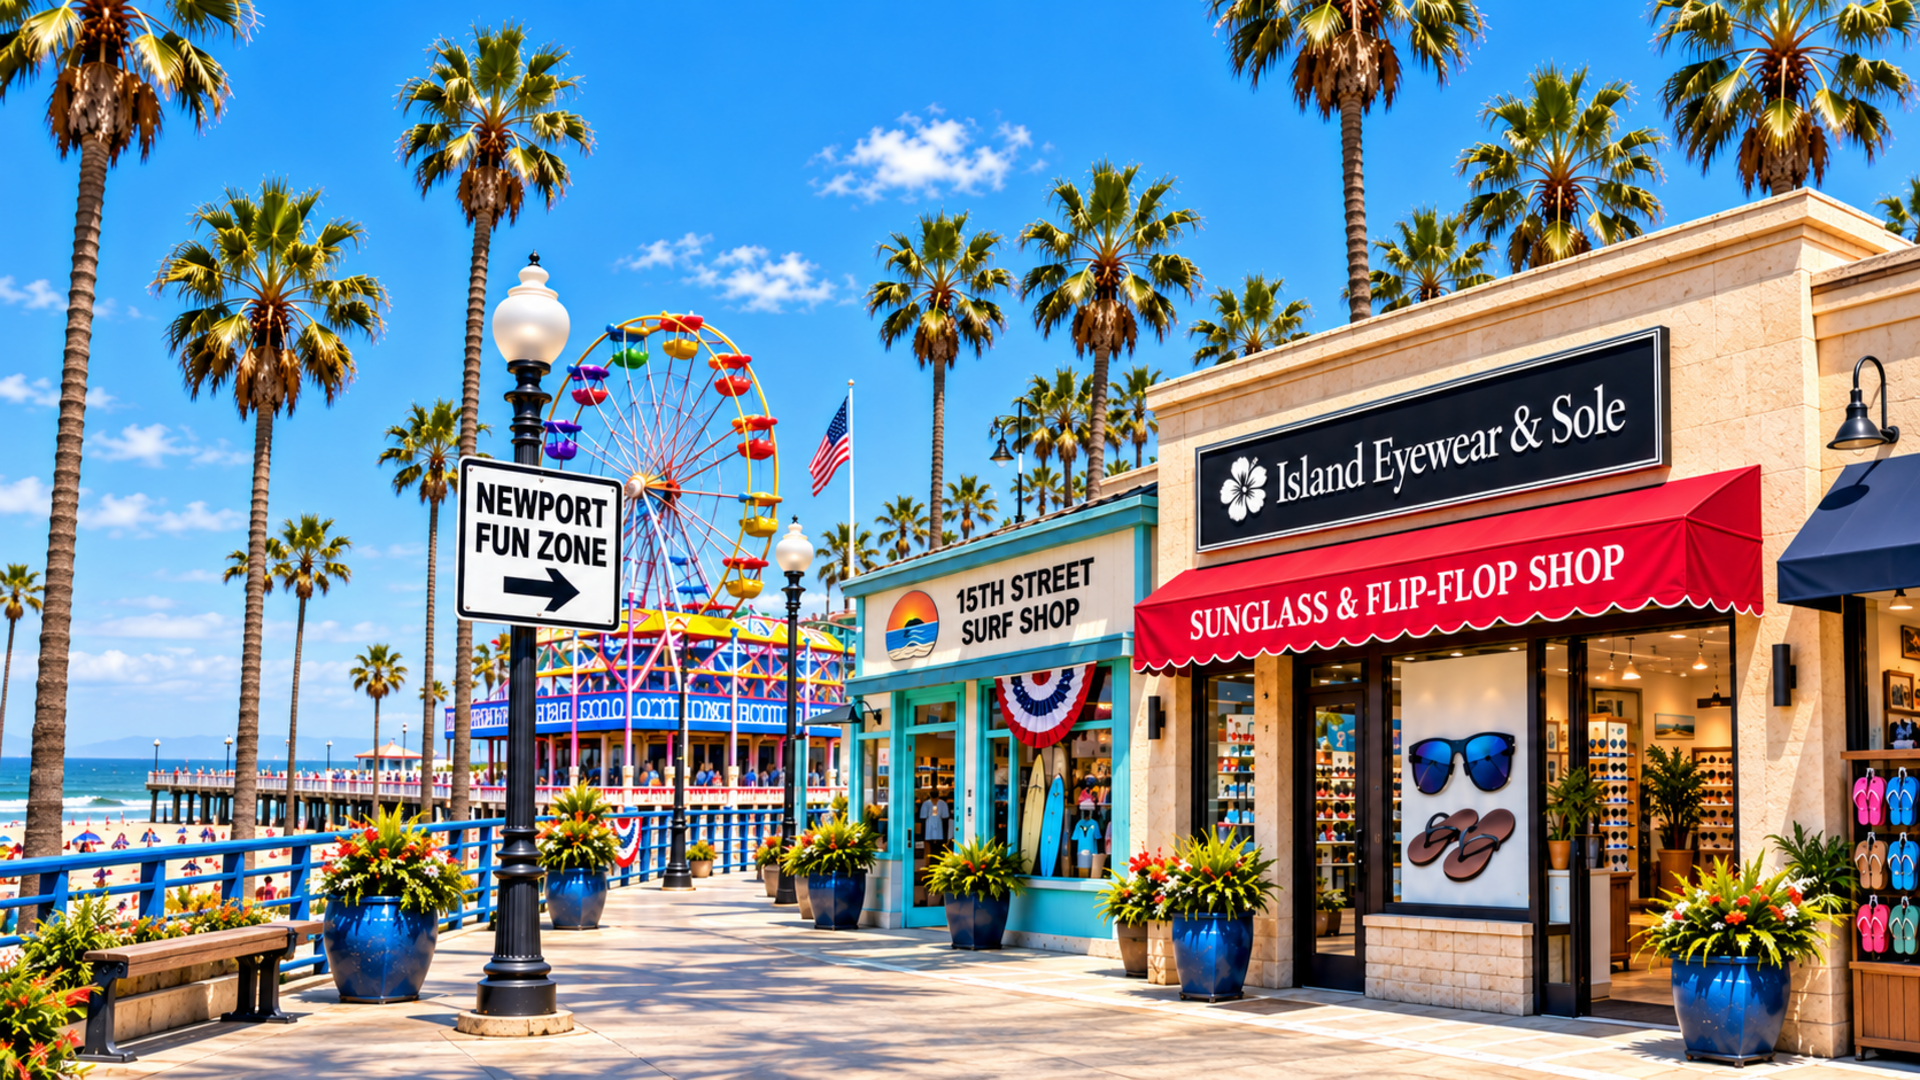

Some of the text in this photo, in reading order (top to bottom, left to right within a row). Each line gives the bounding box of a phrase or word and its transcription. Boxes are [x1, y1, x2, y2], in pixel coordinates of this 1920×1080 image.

[1276, 383, 1626, 504] Island Eyewear & Sole
[475, 481, 608, 529] NEWPORT
[475, 521, 608, 568] FUN ZONE
[956, 556, 1095, 614] 15TH STREET
[1190, 544, 1625, 641] SUNGLASS & FLIP-FLOP SHOP
[961, 597, 1080, 646] SURF SHOP
